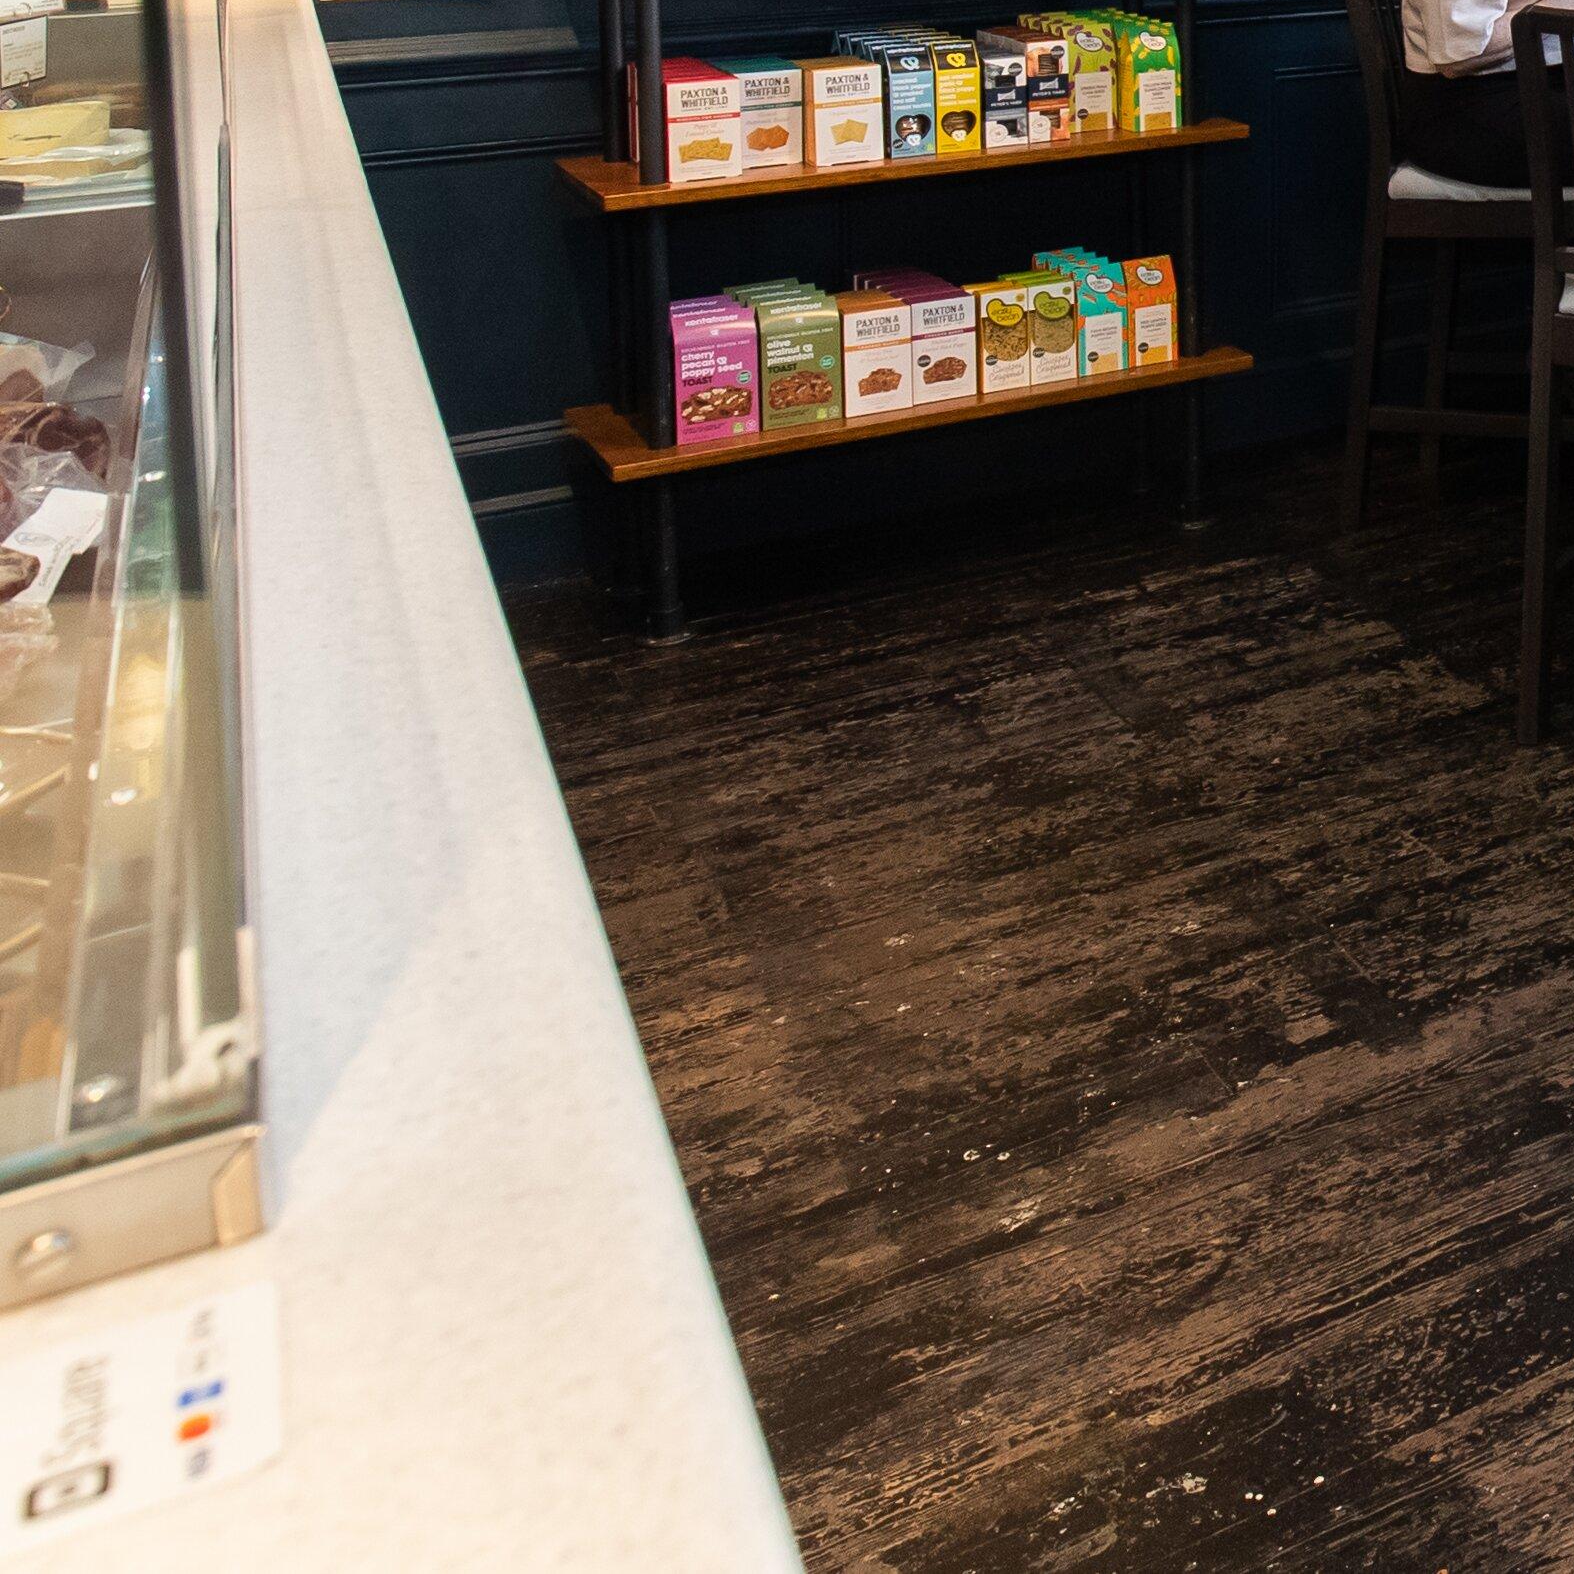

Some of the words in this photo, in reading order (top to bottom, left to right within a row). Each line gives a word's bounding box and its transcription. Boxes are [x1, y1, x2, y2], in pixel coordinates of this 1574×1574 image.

[745, 78, 781, 88] PAXTON
[783, 77, 789, 85] &
[826, 75, 862, 86] PAXTON
[863, 74, 869, 82] &
[681, 88, 719, 99] PAXTON
[720, 87, 727, 95] &
[745, 86, 790, 98] WHITFIELD
[827, 82, 871, 94] WHITFIELD
[682, 96, 729, 108] WHITFIELD
[923, 305, 957, 317] PAXTON
[958, 304, 964, 312] &
[856, 317, 892, 328] PAXTON
[893, 315, 899, 323] &
[923, 313, 965, 326] WHITFIELD
[857, 324, 901, 337] WHITFIELD
[767, 340, 791, 349] olive
[681, 351, 715, 362] cherry
[767, 346, 800, 357] walnut
[682, 359, 715, 371] pecan
[682, 368, 716, 379] poppy
[718, 362, 743, 373] seed
[768, 363, 797, 373] TOAST
[683, 377, 713, 387] TOAST
